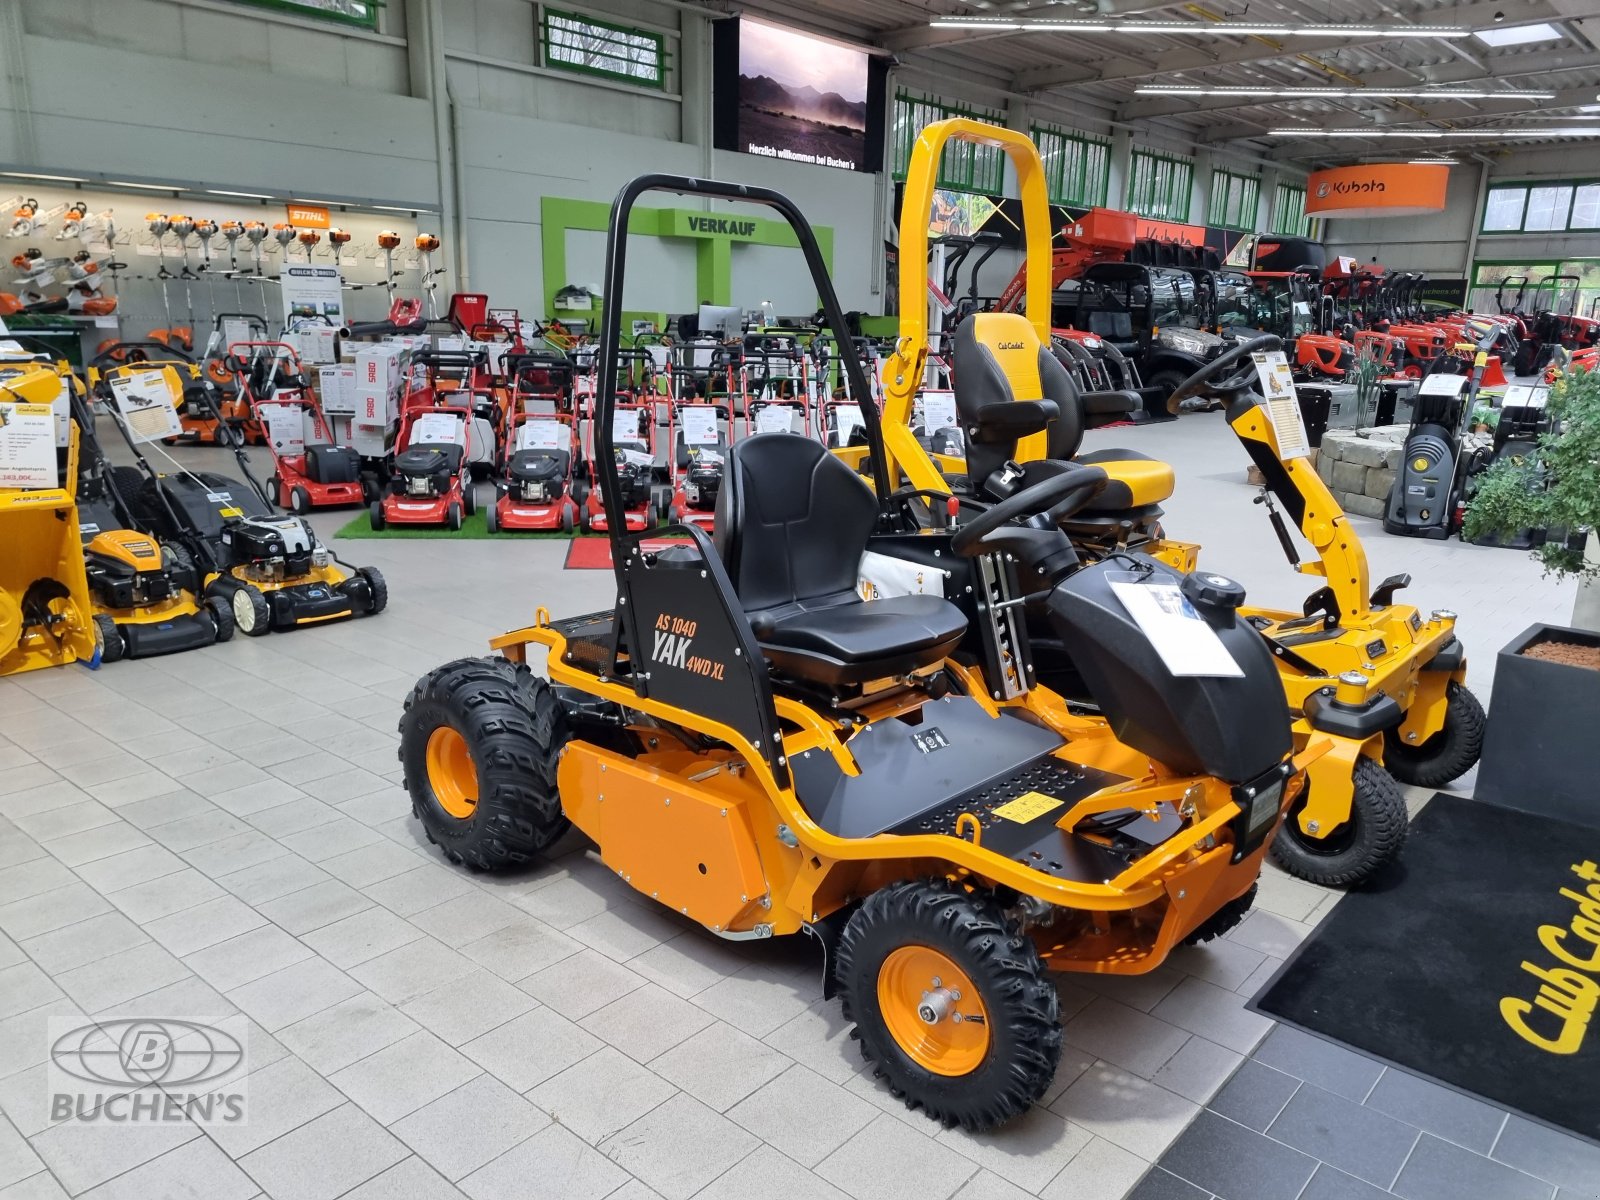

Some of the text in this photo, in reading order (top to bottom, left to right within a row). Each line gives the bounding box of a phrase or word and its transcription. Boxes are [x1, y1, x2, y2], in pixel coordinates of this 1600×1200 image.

[748, 143, 777, 157] Herzlich
[777, 149, 816, 163] willkommen
[816, 155, 826, 165] bei
[1333, 179, 1385, 194] Kubota
[292, 210, 325, 221] STIHL
[687, 216, 756, 236] VERKAUF
[368, 362, 376, 383] SABO
[367, 397, 375, 418] SABO
[655, 613, 697, 638] AS 1040
[651, 630, 725, 681] YAK 4WD XL
